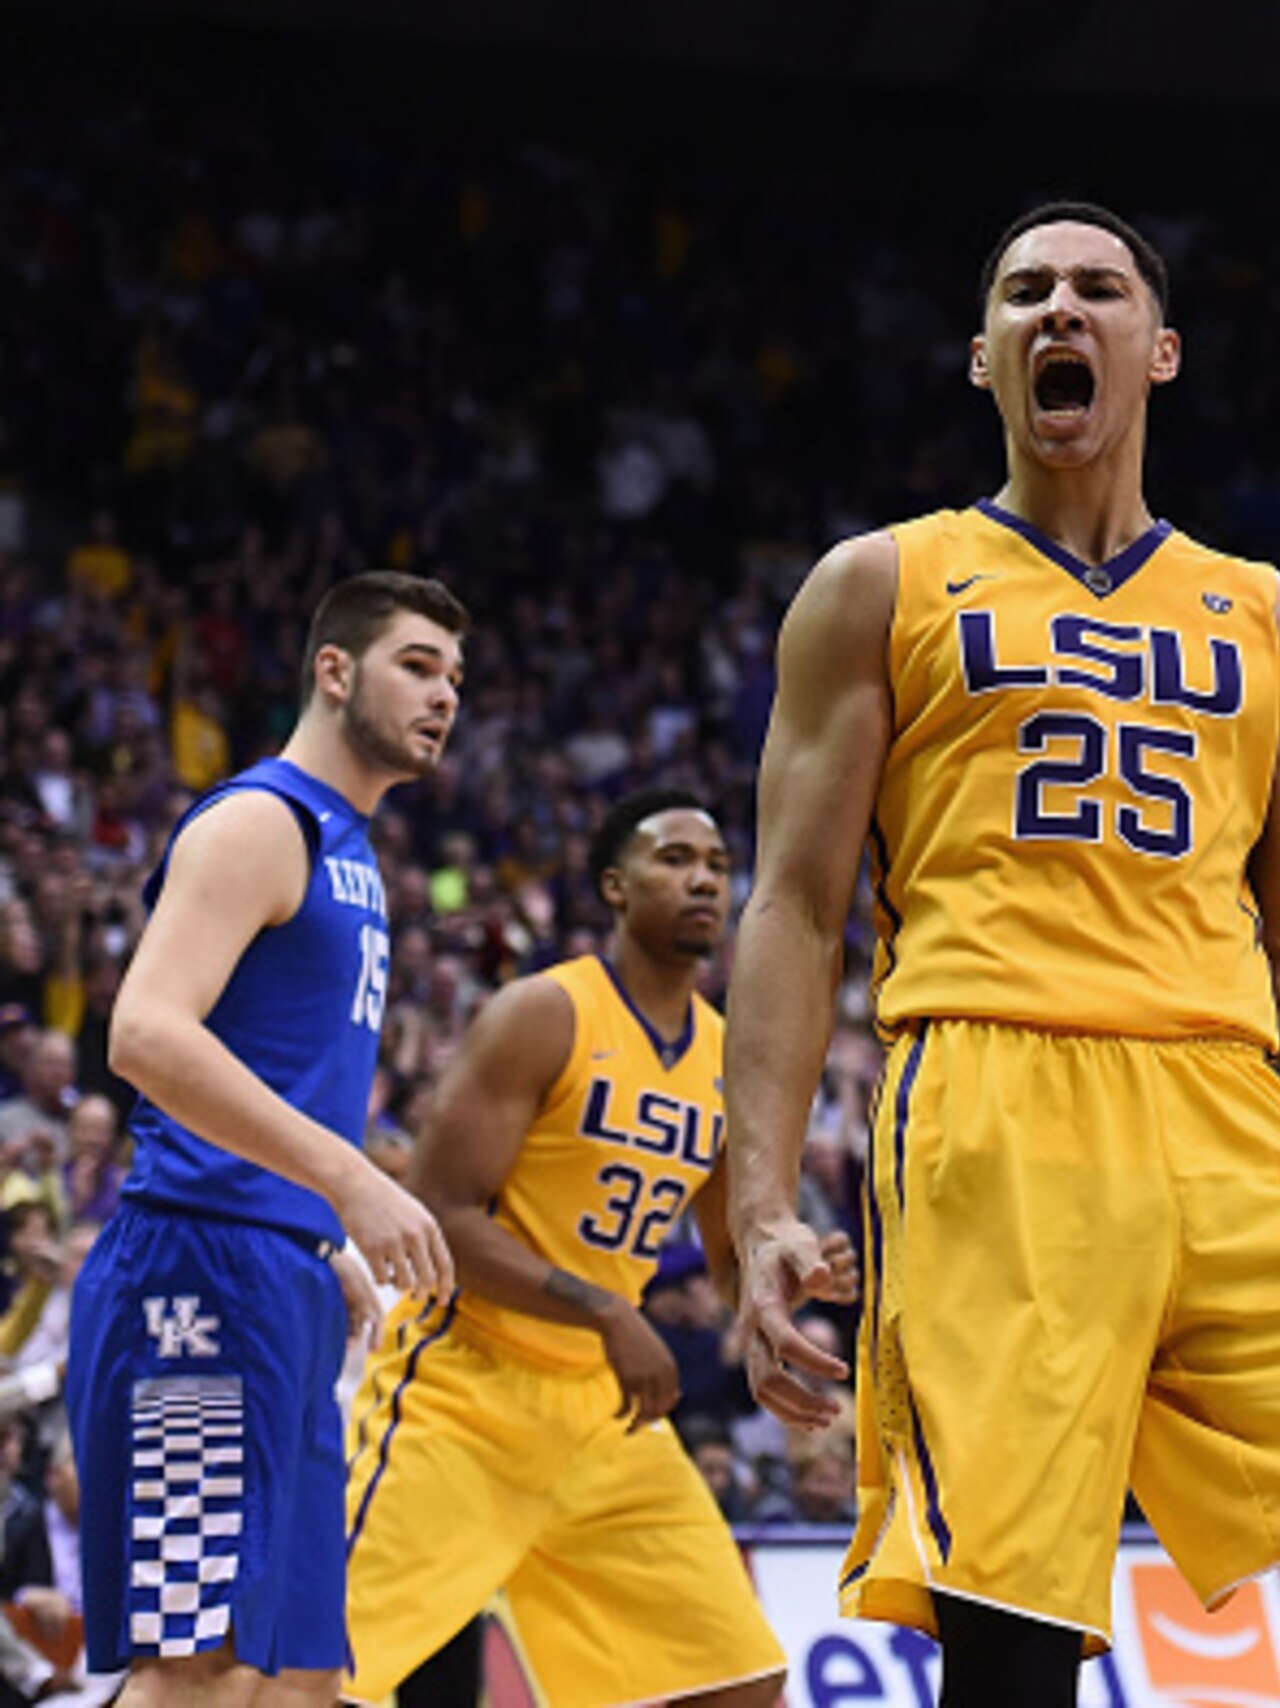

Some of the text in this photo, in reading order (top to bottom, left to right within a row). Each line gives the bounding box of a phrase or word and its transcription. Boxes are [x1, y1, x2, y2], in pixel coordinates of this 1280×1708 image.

[957, 611, 1243, 717] LSU
[1011, 708, 1197, 861] 25
[350, 923, 390, 1032] 15
[580, 1077, 724, 1173] LSU
[577, 1161, 688, 1262] 32
[142, 1296, 221, 1358] UK
